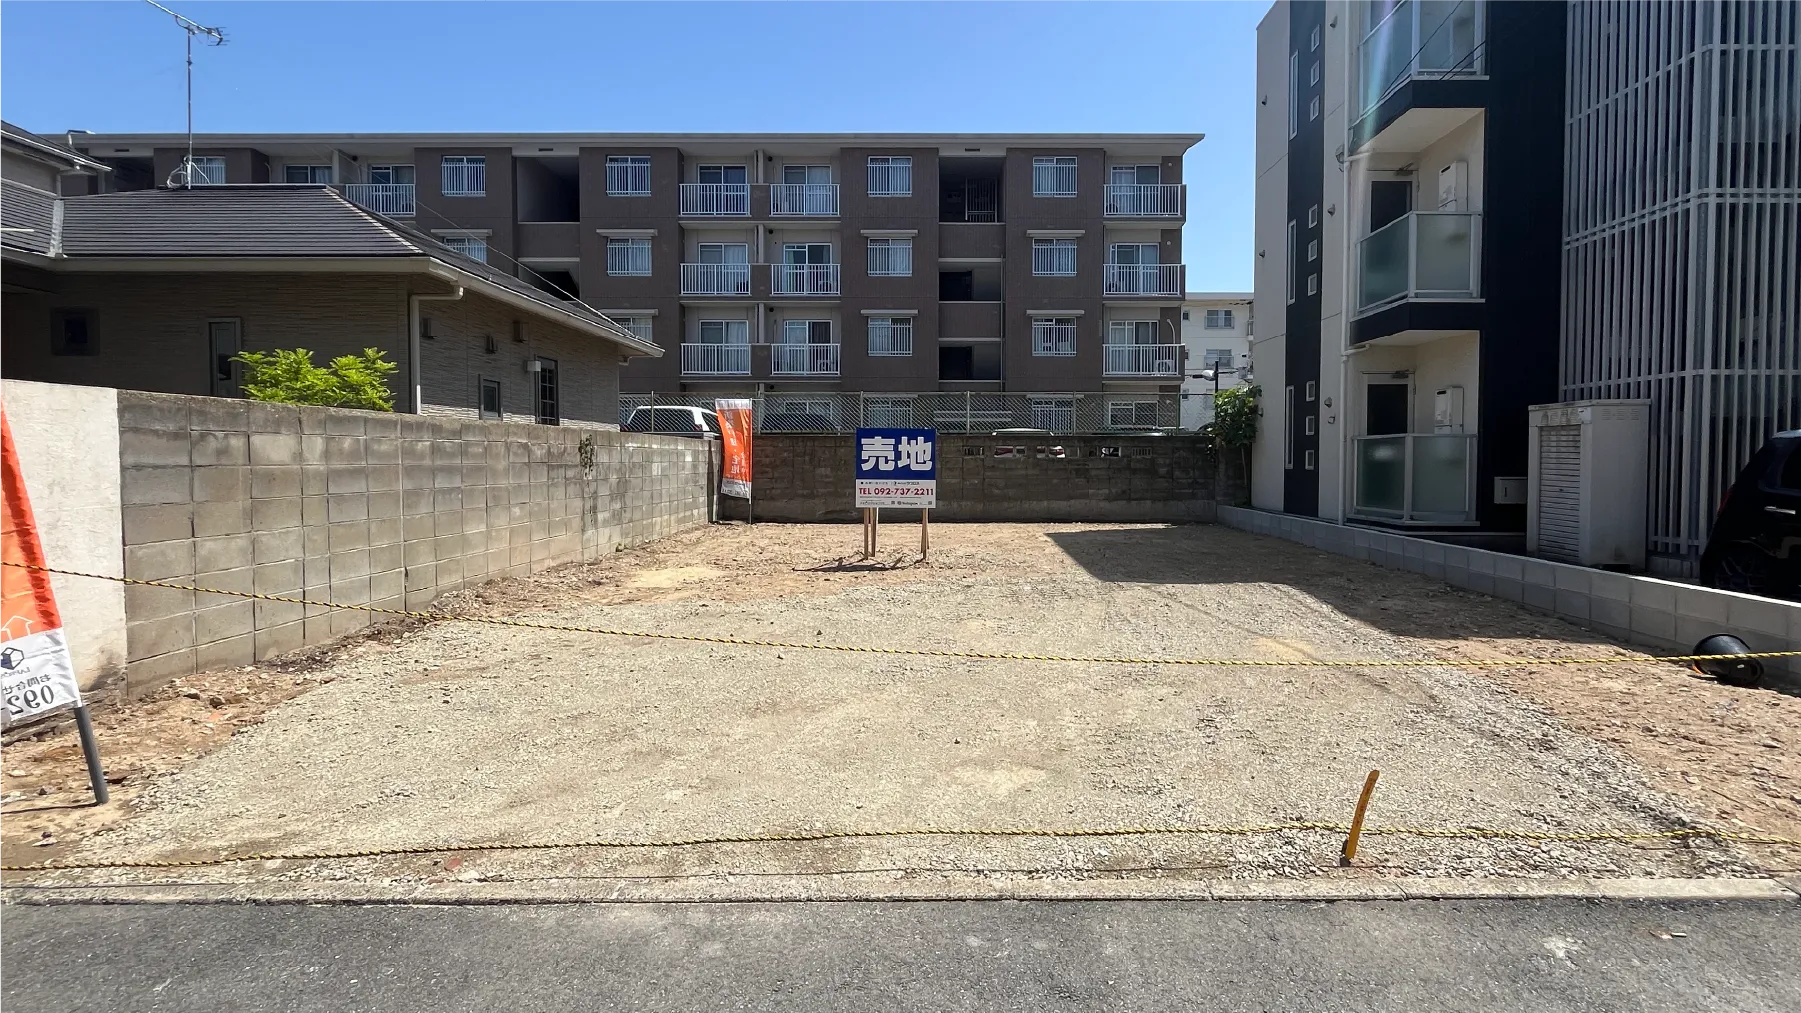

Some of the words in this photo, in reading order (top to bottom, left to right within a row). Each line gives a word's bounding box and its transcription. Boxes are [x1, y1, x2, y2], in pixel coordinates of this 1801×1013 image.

[861, 436, 933, 471] 売地
[859, 487, 872, 495] TEL
[874, 487, 934, 496] 092-737-2211
